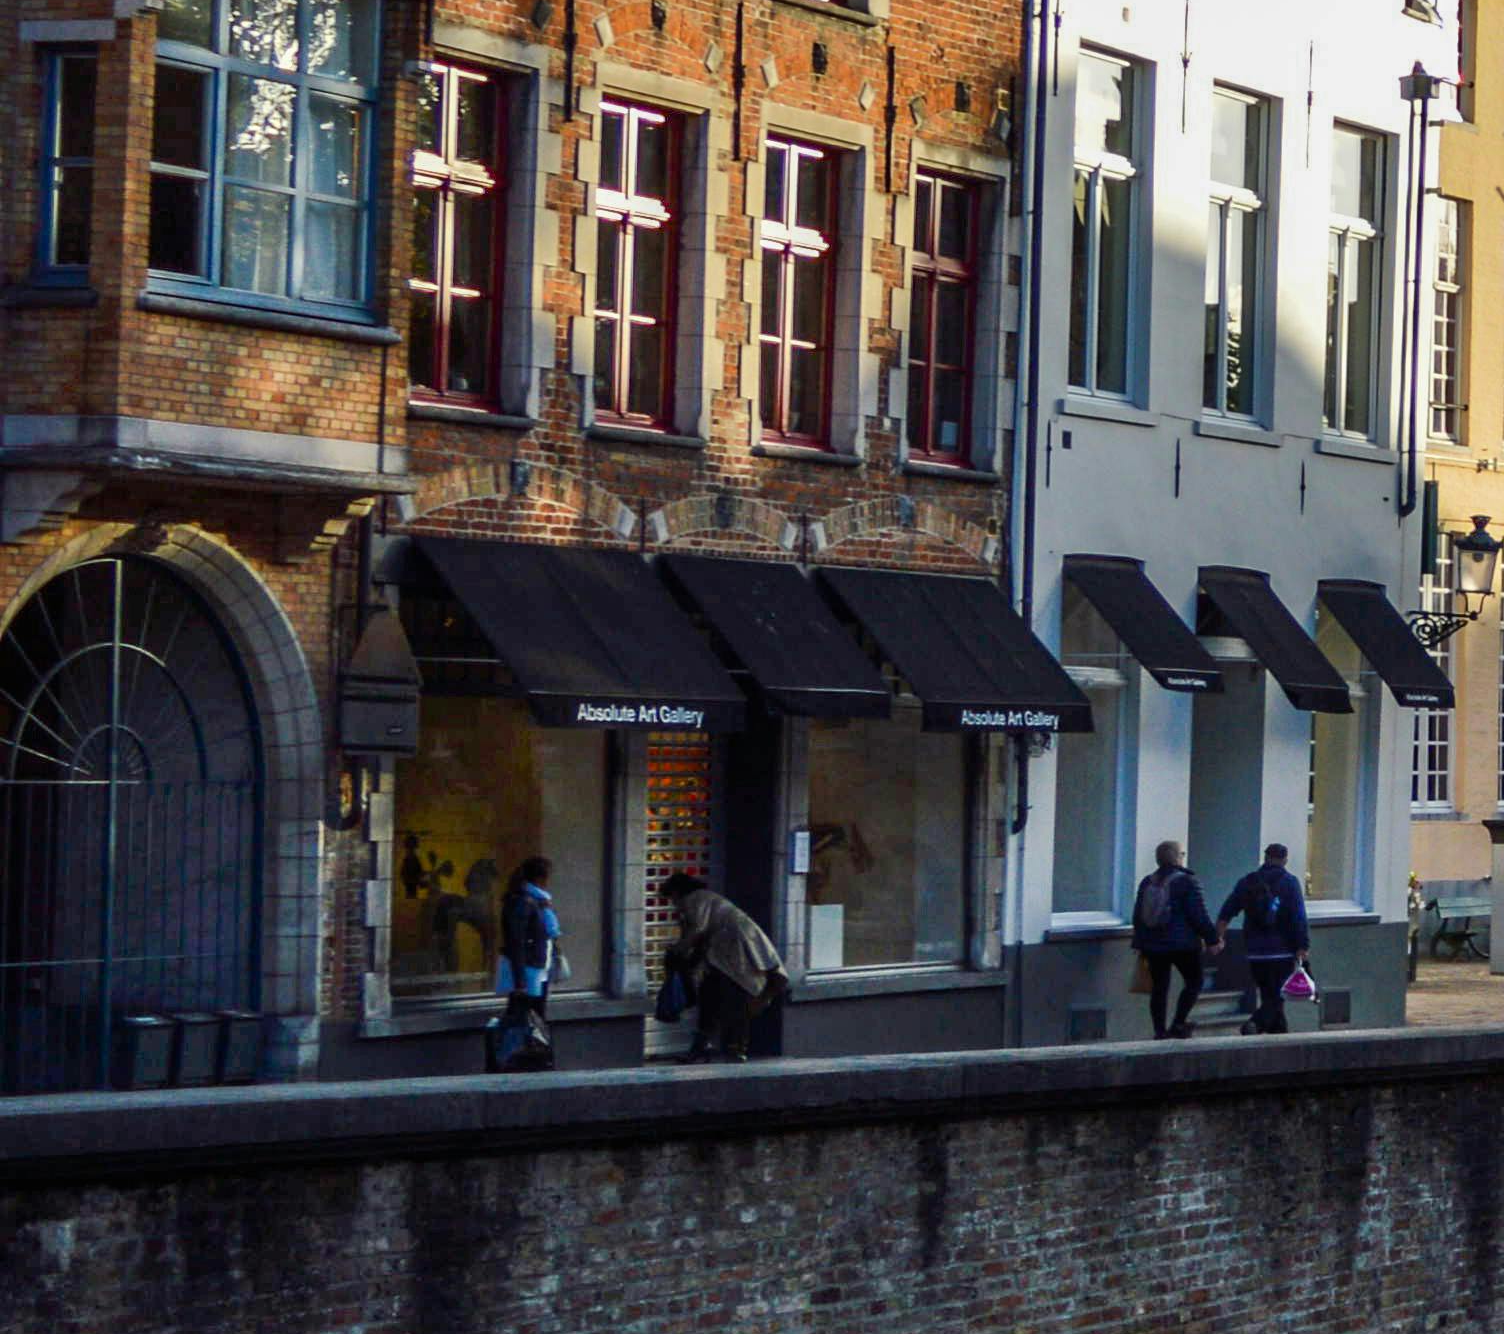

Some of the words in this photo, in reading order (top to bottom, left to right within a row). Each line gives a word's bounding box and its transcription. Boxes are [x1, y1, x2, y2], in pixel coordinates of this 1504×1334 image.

[577, 702, 636, 722] Absolute
[638, 704, 658, 723] Art
[659, 705, 705, 729] Gallery
[961, 709, 1006, 726] Absolute
[1007, 710, 1023, 726] Art
[1024, 710, 1060, 730] Gallery
